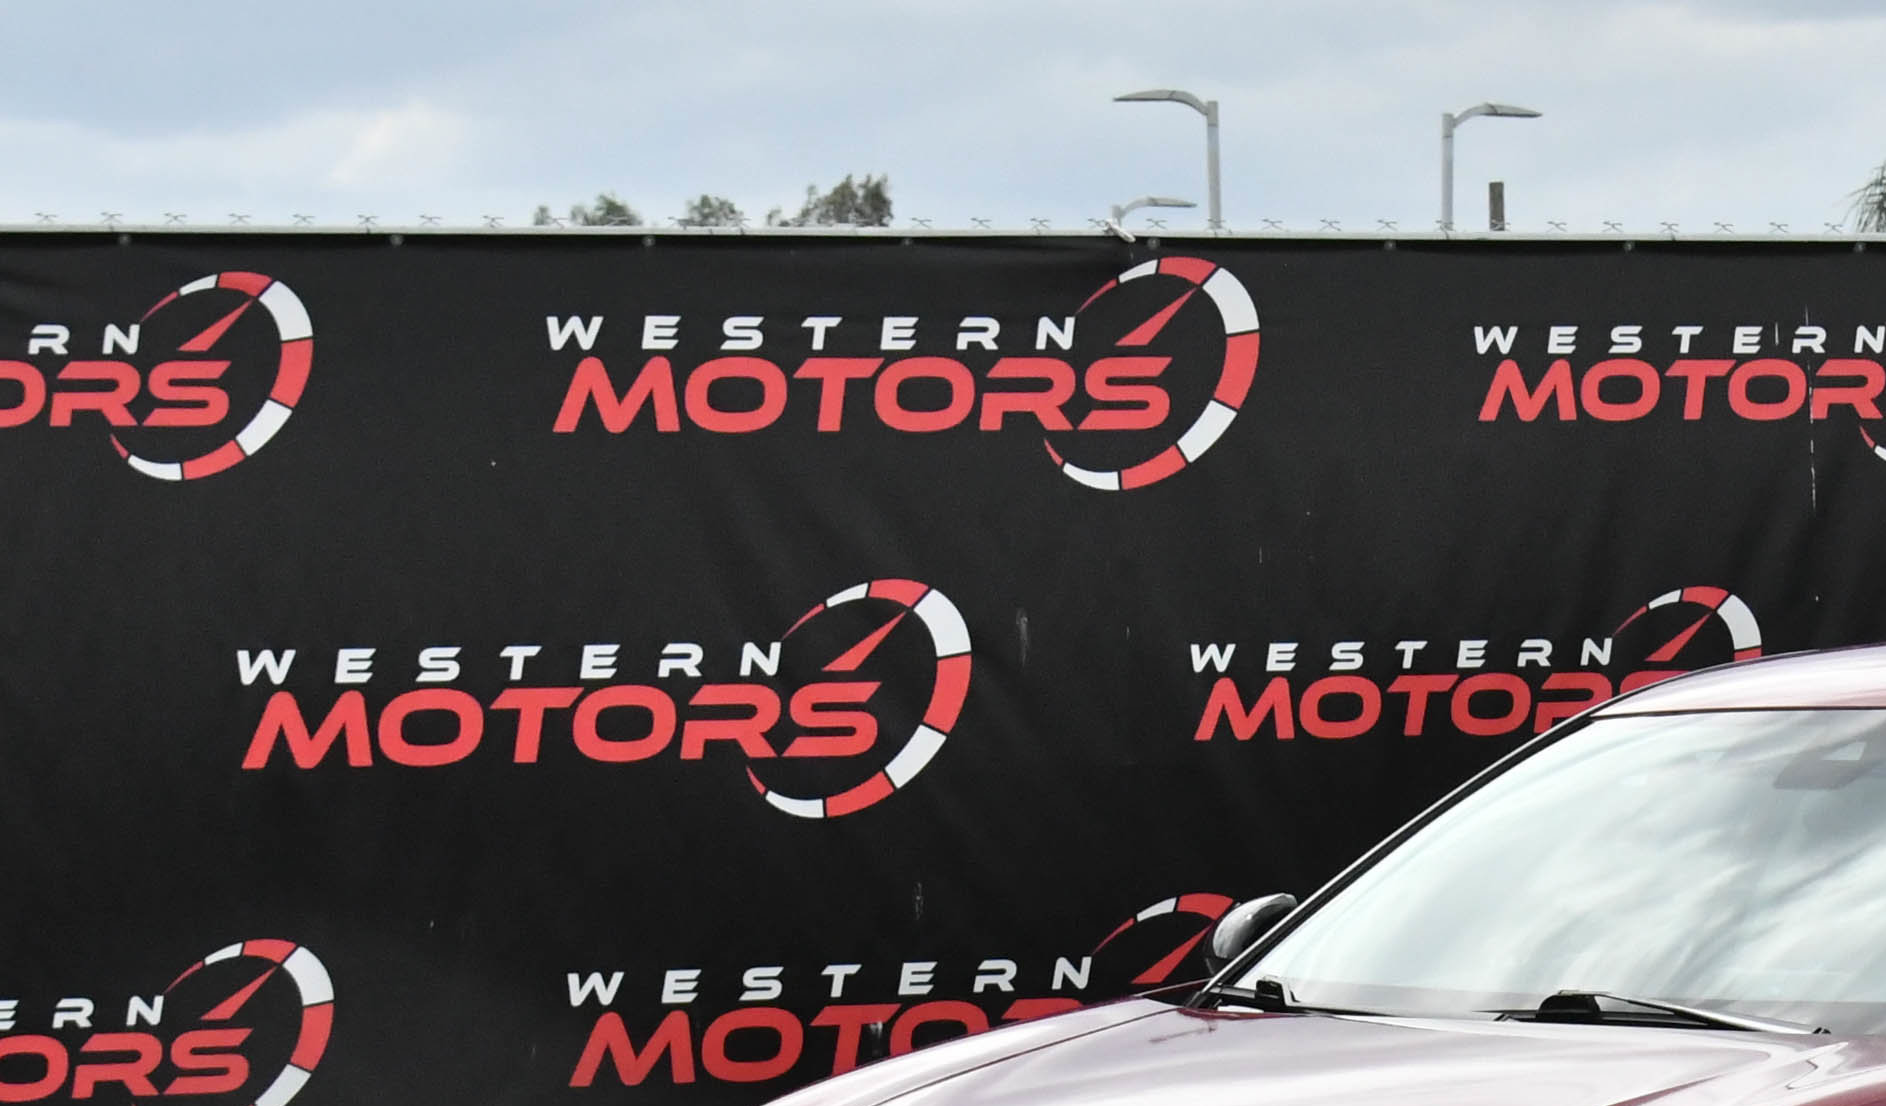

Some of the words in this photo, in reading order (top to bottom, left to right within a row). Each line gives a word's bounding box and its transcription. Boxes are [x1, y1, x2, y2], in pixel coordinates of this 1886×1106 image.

[547, 315, 1076, 351] WESTERN
[1473, 325, 1886, 355] WESTERN
[553, 356, 1173, 434] MOTORS
[237, 641, 782, 686] WESTERN
[1190, 637, 1613, 673] WESTERN
[241, 682, 881, 770] MOTORS
[1194, 671, 1690, 741] MOTOR
[567, 956, 1092, 1007] WESTERN
[569, 997, 1085, 1087] MOTO
